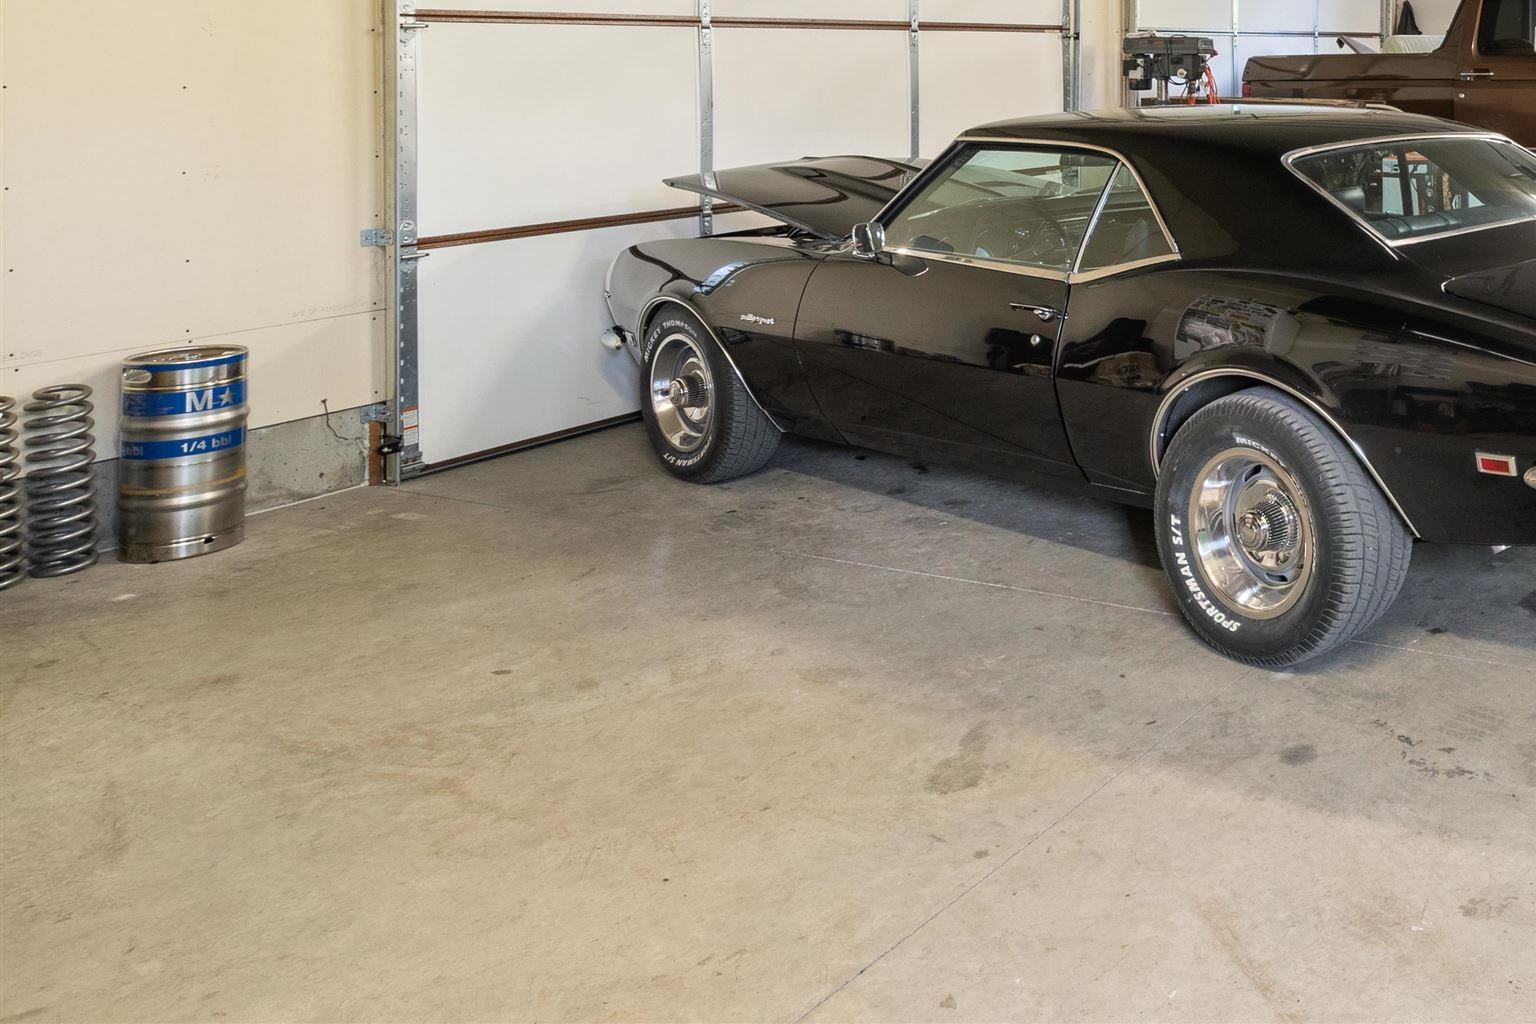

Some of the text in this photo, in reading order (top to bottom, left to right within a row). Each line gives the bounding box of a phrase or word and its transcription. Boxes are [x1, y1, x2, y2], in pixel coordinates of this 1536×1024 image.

[643, 326, 661, 363] MICKEY
[180, 433, 232, 453] 1/4 bbl
[1171, 514, 1241, 633] SPORTSMAN S/T
